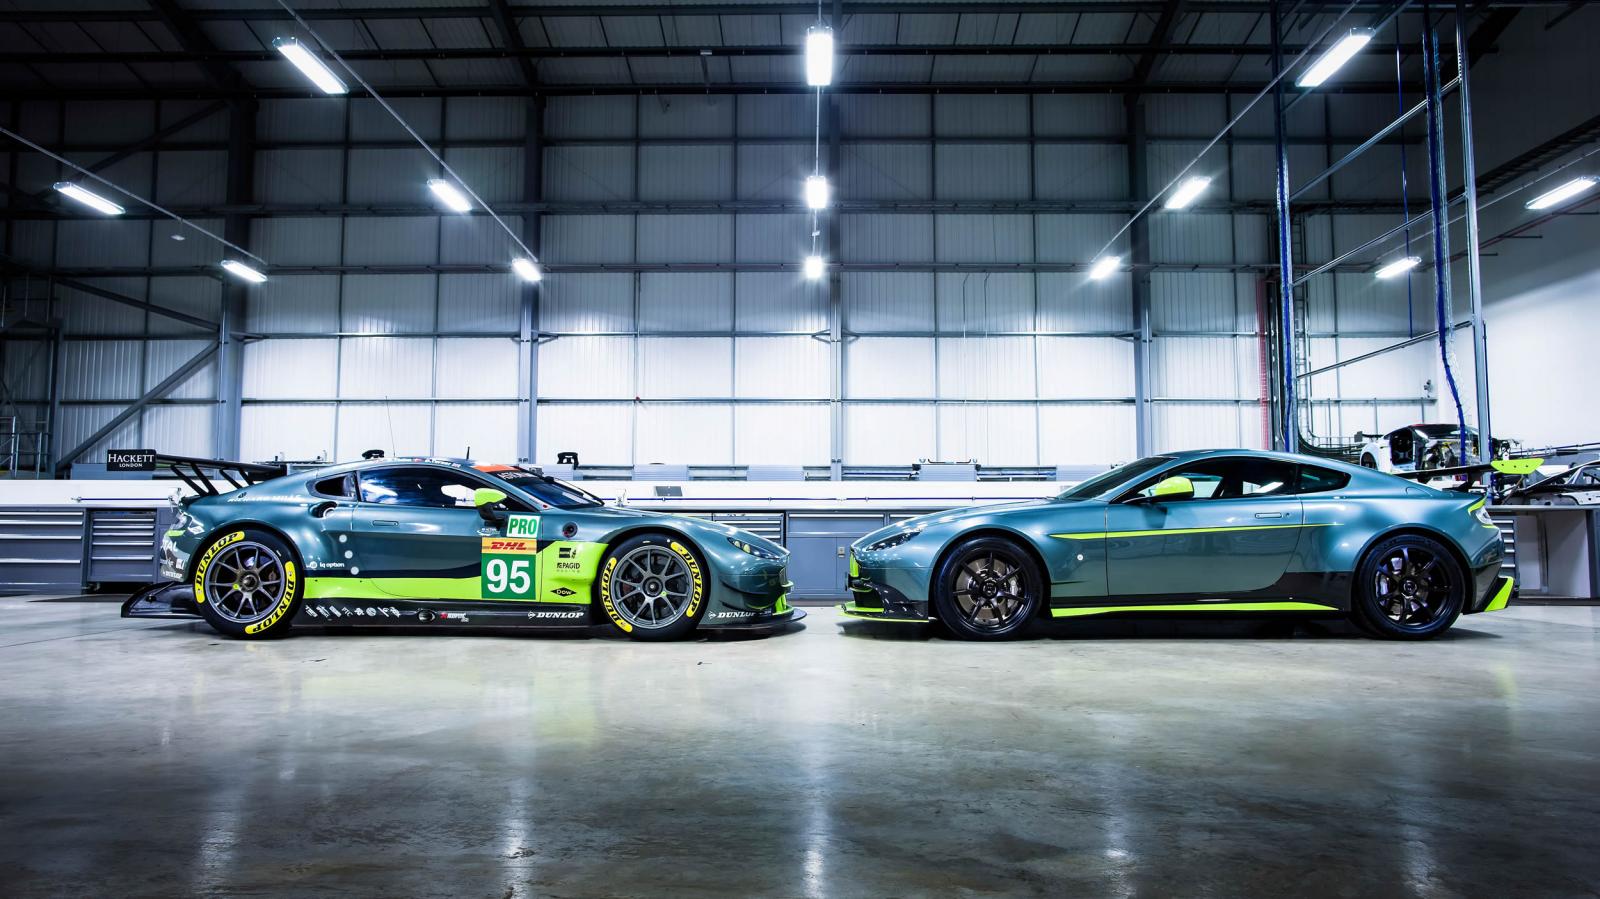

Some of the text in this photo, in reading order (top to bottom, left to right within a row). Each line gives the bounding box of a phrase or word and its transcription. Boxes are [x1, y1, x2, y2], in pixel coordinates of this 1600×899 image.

[108, 453, 155, 463] HACKETT
[490, 541, 527, 551] DHL
[508, 518, 537, 535] PRO
[196, 532, 237, 587] DUNLOP
[486, 558, 531, 594] 95
[602, 562, 620, 622] DUNLOP
[684, 553, 702, 613] DUNLOP
[252, 581, 295, 633] DUNLOP
